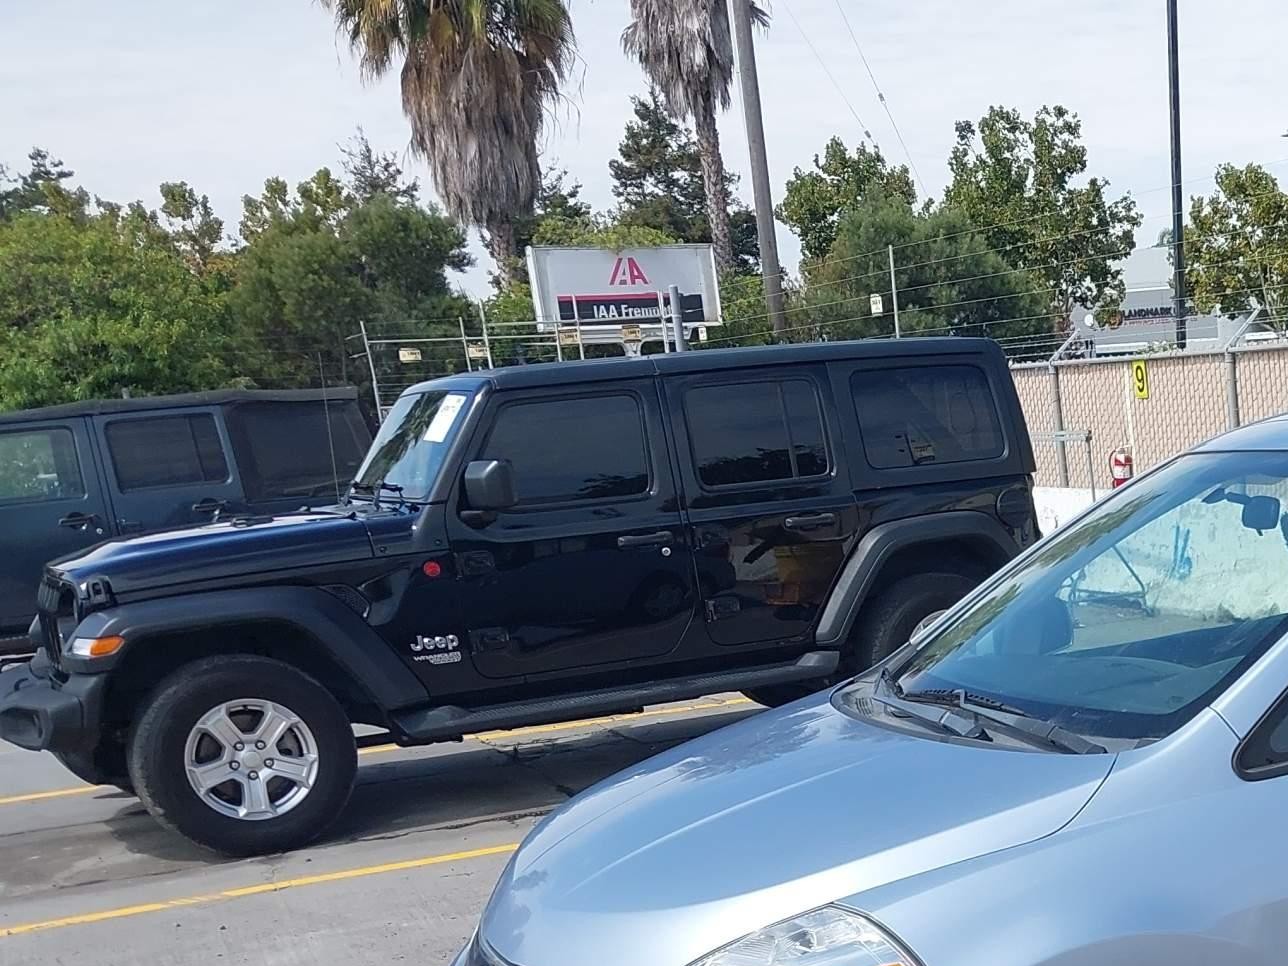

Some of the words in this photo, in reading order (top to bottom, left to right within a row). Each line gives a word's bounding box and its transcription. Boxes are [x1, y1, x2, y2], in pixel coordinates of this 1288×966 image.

[593, 304, 619, 319] IAA
[1135, 365, 1145, 393] 9
[410, 634, 459, 652] Jeep
